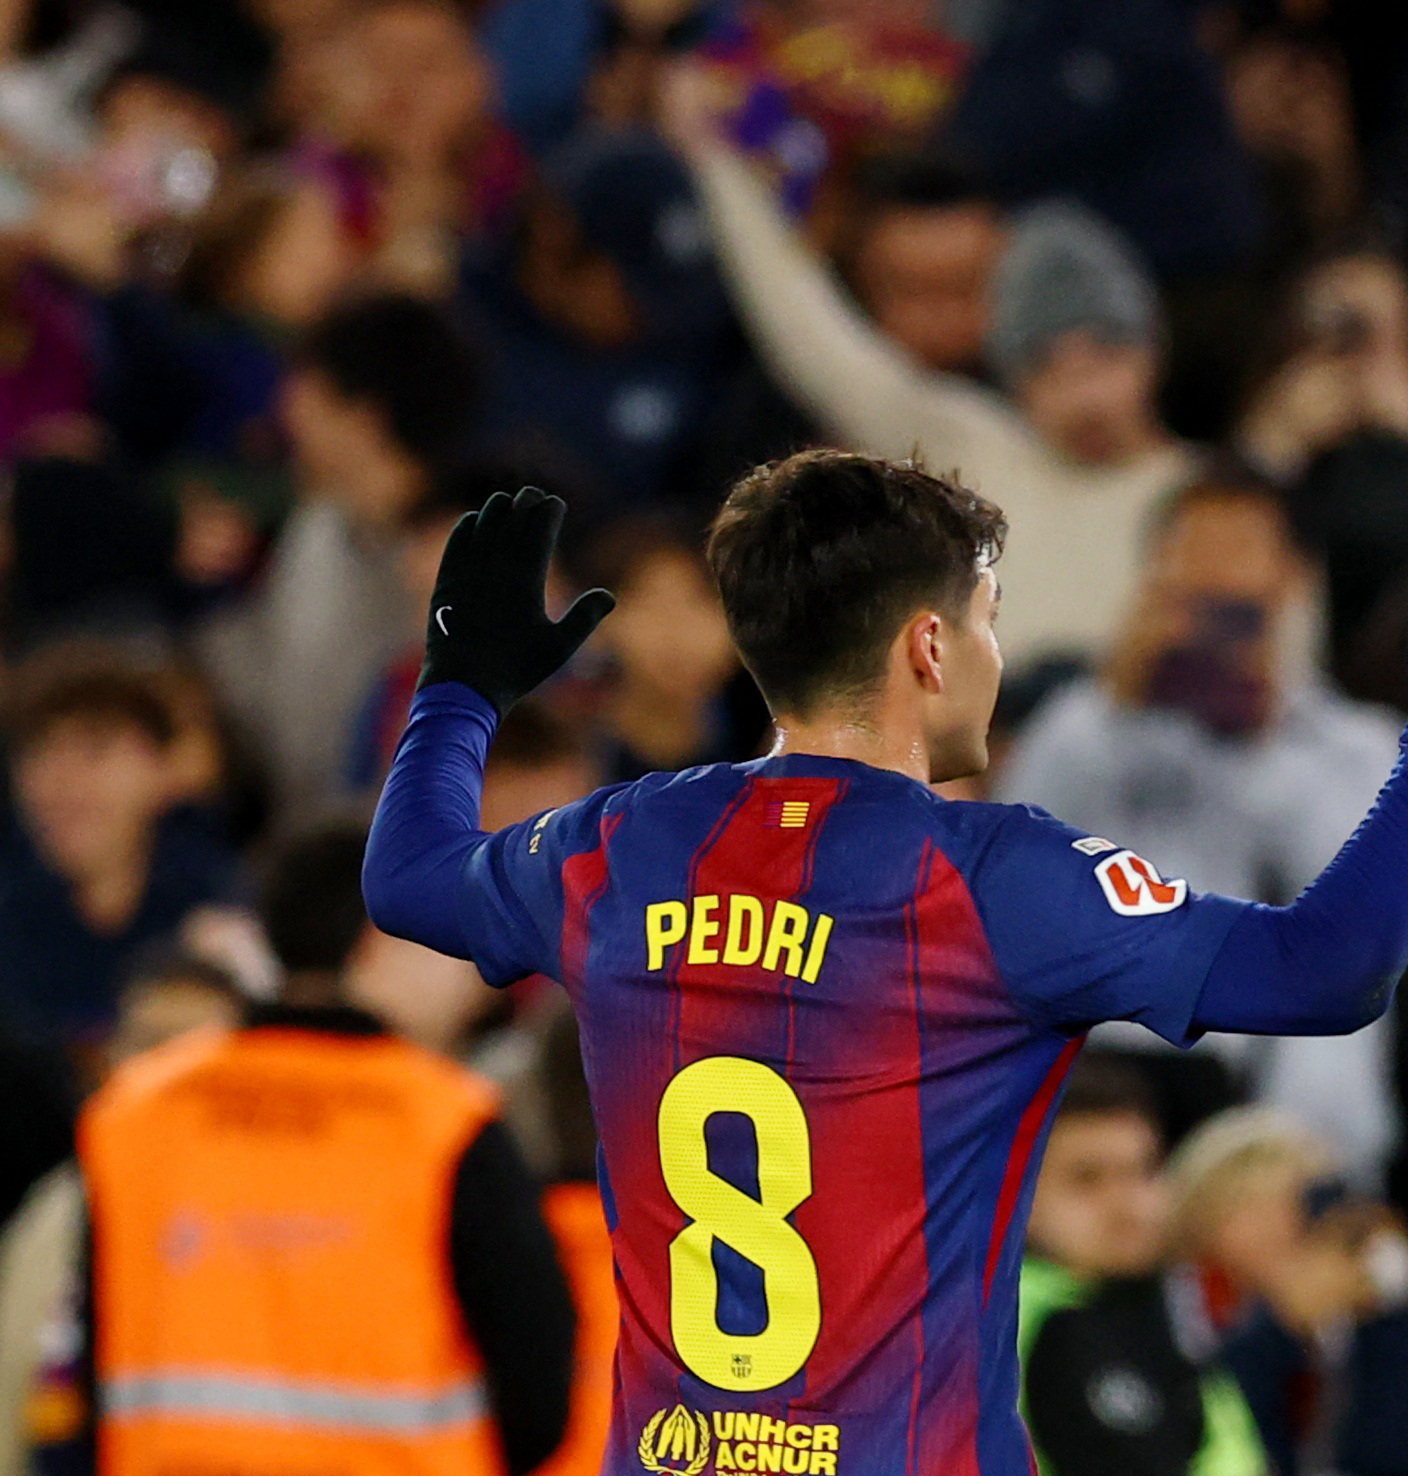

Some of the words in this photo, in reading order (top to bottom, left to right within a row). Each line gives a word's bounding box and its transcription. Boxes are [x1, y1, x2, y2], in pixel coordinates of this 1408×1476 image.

[646, 894, 834, 984] PEDRI
[658, 1057, 821, 1391] 8
[712, 1411, 840, 1450] UNHCR
[714, 1441, 838, 1476] ACNUR
